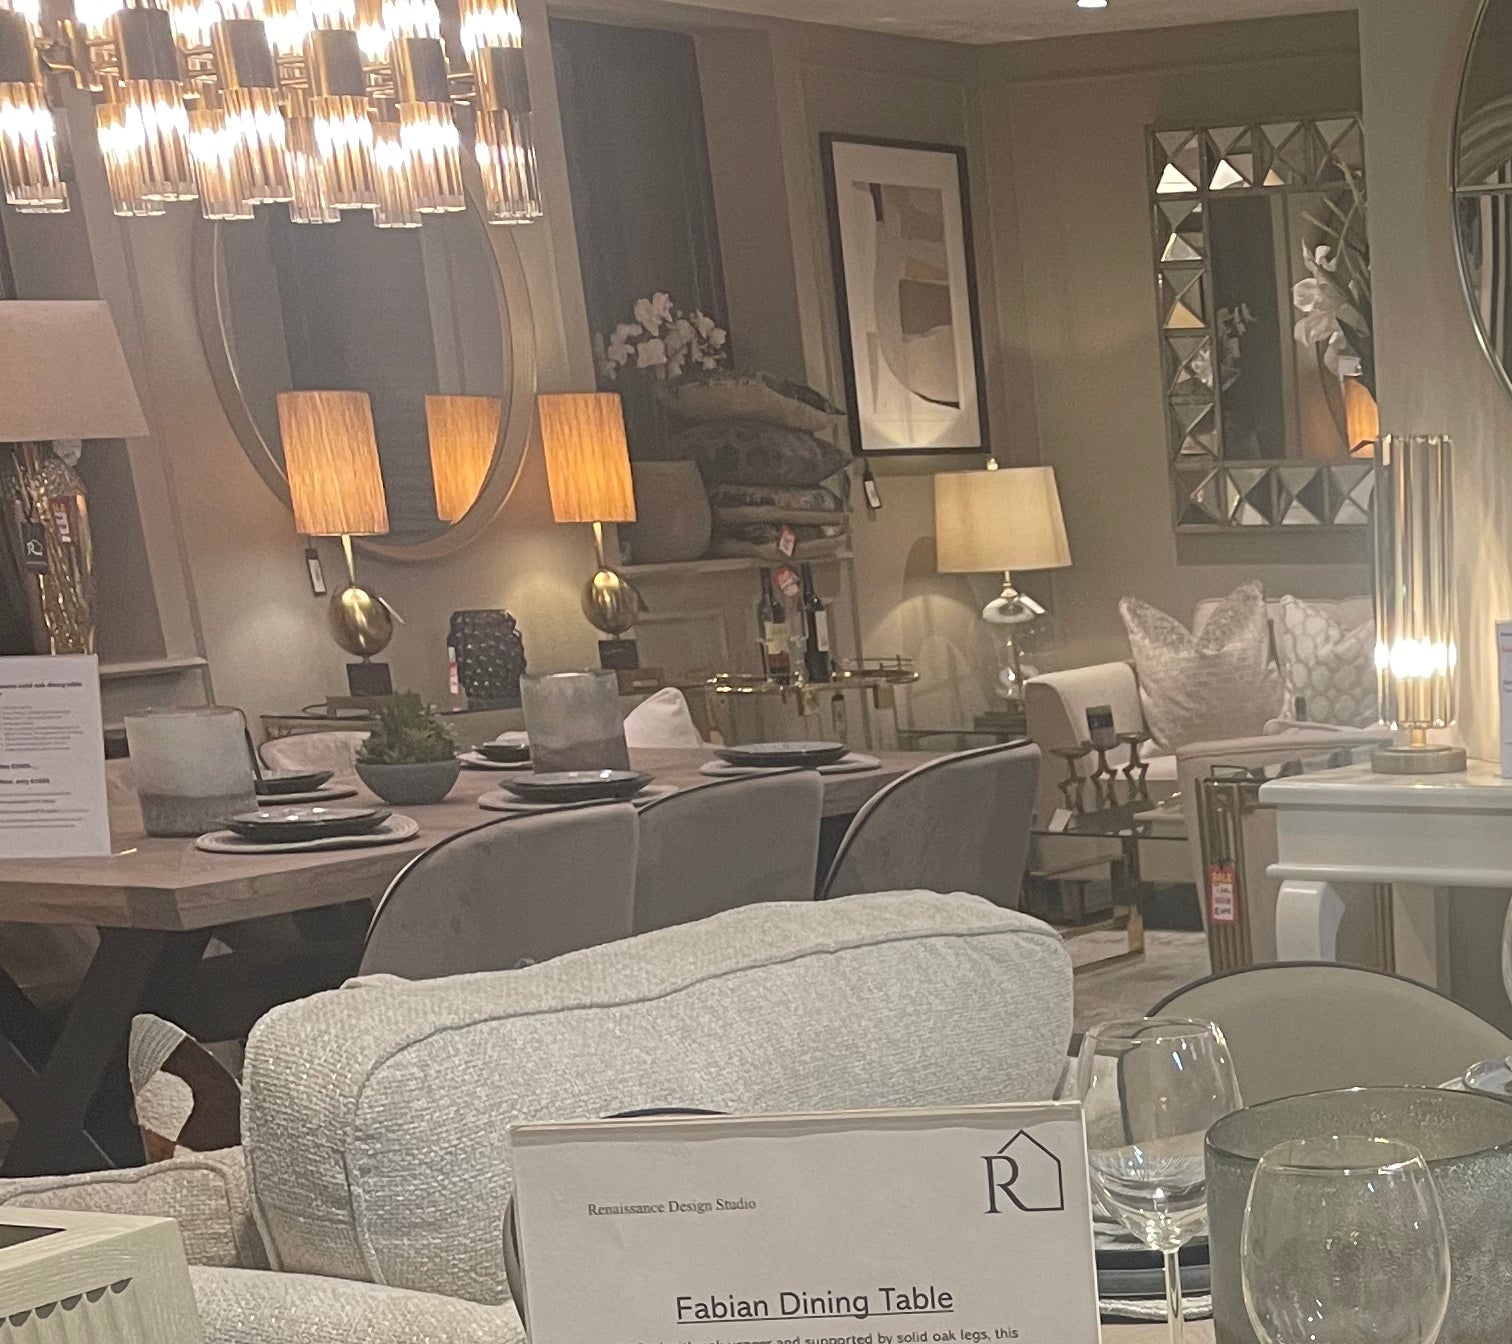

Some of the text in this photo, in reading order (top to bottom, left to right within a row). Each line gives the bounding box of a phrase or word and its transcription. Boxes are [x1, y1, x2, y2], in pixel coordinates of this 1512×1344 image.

[587, 1196, 757, 1217] Renaissance Design Studio
[676, 1285, 953, 1321] Fabian Dining Table
[896, 1330, 928, 1344] solid
[932, 1329, 957, 1343] oak
[960, 1328, 991, 1344] legs,
[994, 1327, 1019, 1340] this
